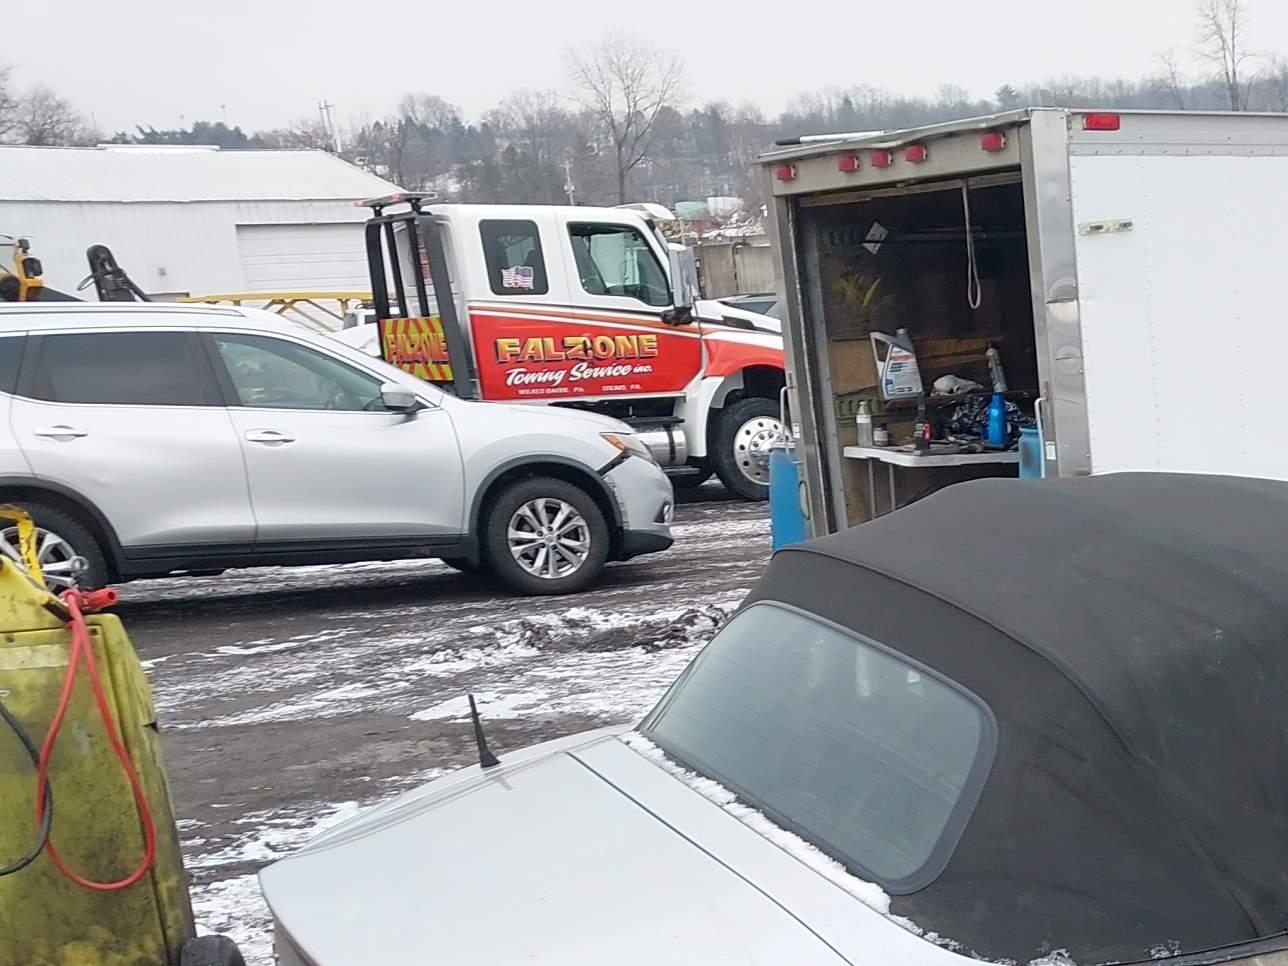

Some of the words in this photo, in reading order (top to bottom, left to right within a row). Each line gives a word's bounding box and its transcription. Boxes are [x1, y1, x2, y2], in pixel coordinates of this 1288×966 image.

[495, 334, 659, 362] FALZONE
[505, 367, 568, 387] Towing
[569, 361, 633, 382] Service
